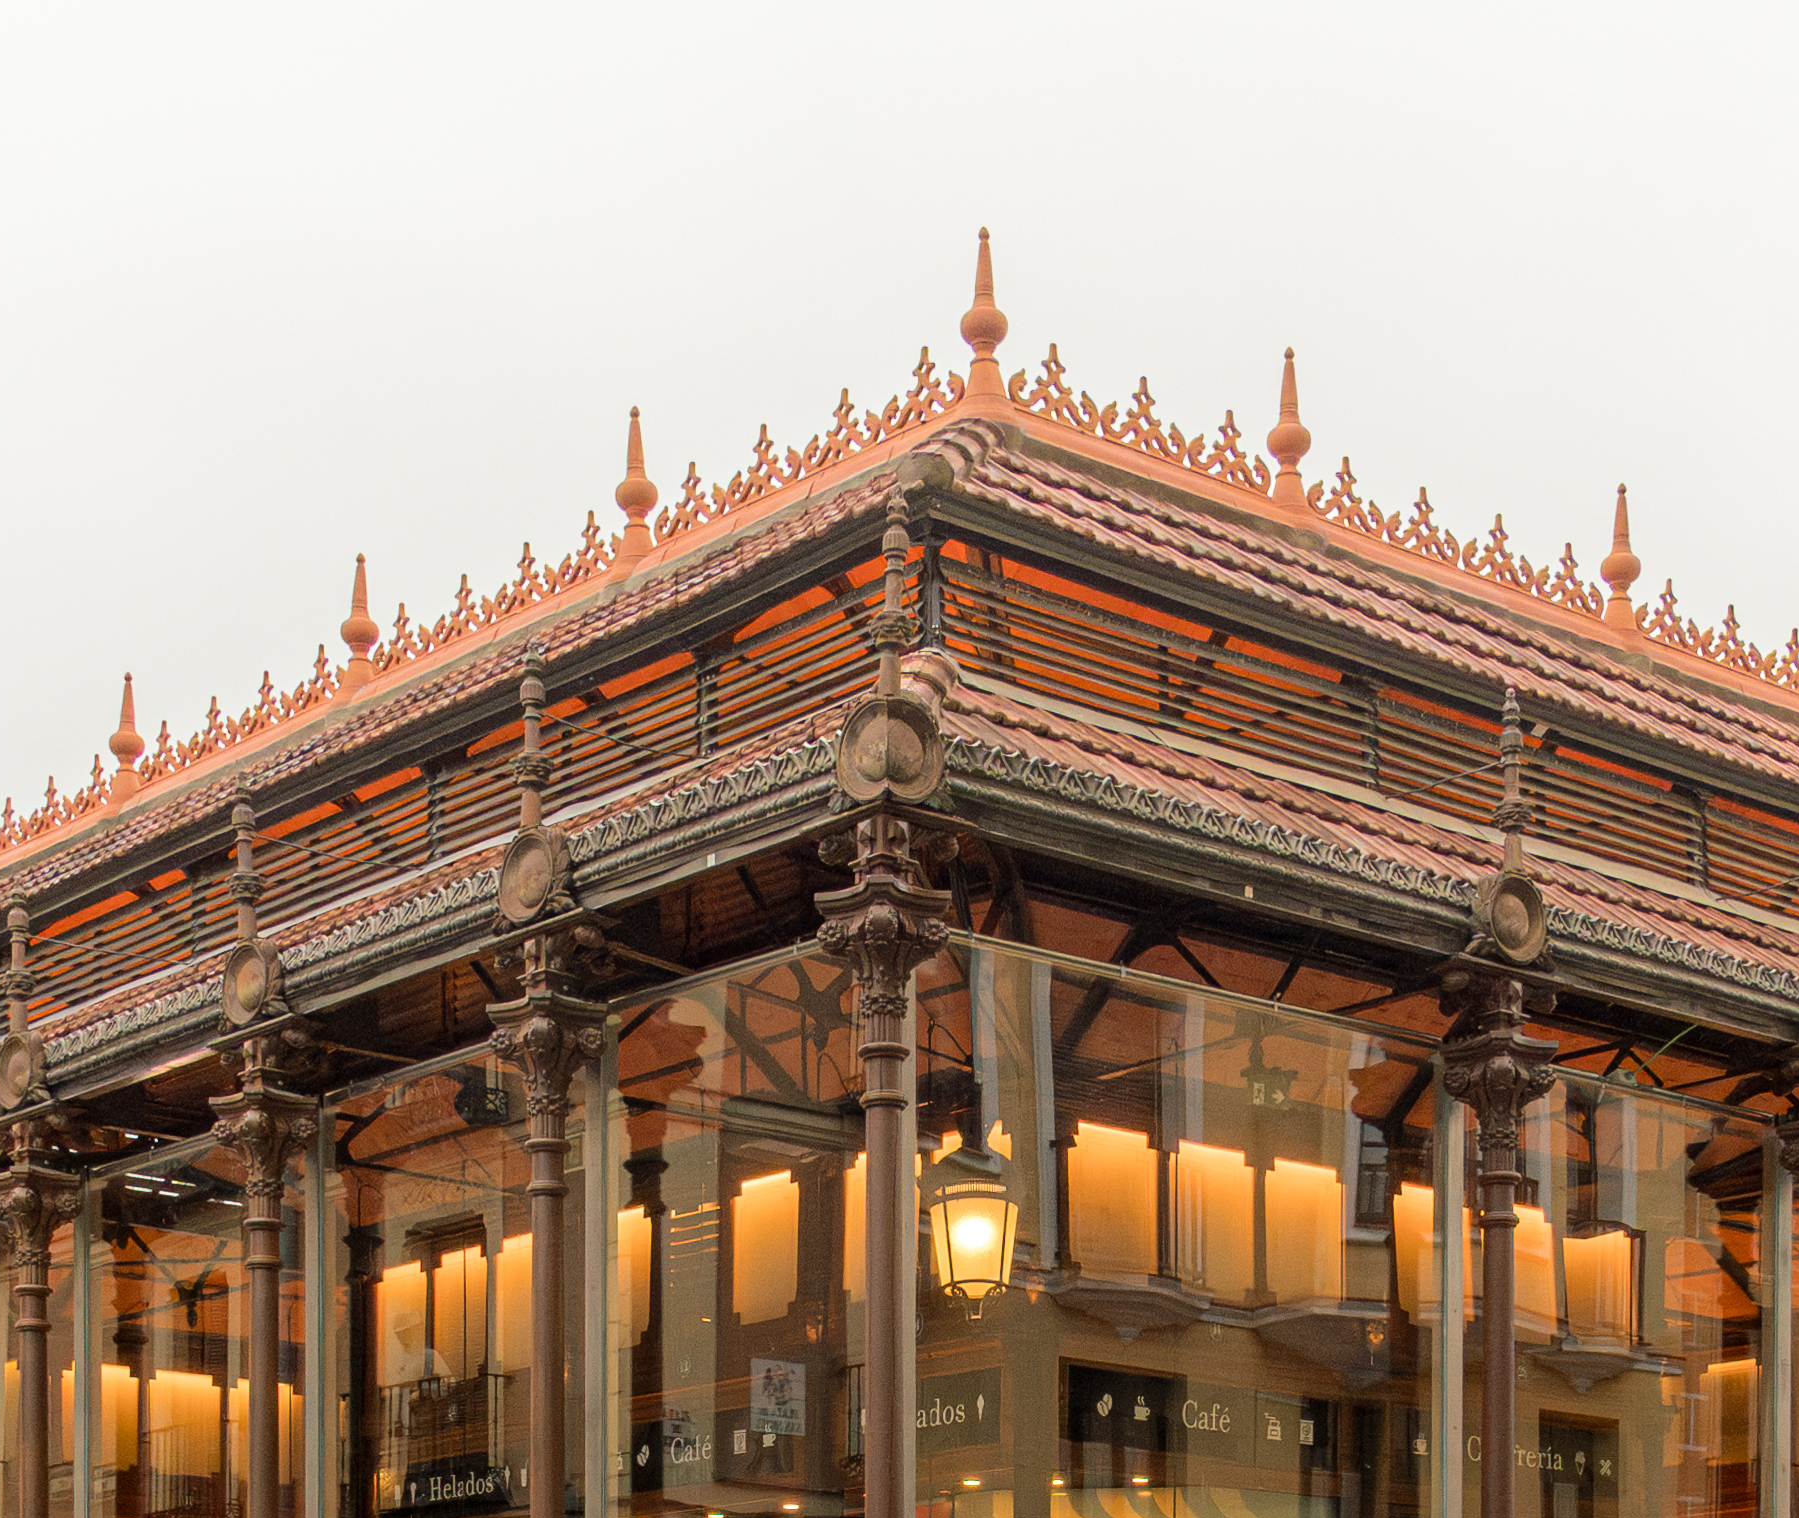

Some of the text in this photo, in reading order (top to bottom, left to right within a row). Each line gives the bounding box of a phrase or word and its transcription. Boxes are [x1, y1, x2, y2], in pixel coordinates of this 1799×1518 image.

[916, 1398, 966, 1428] ados
[1181, 1400, 1231, 1434] Café
[671, 1434, 712, 1464] Café
[1467, 1435, 1564, 1472] Crería
[429, 1473, 495, 1503] Helados
